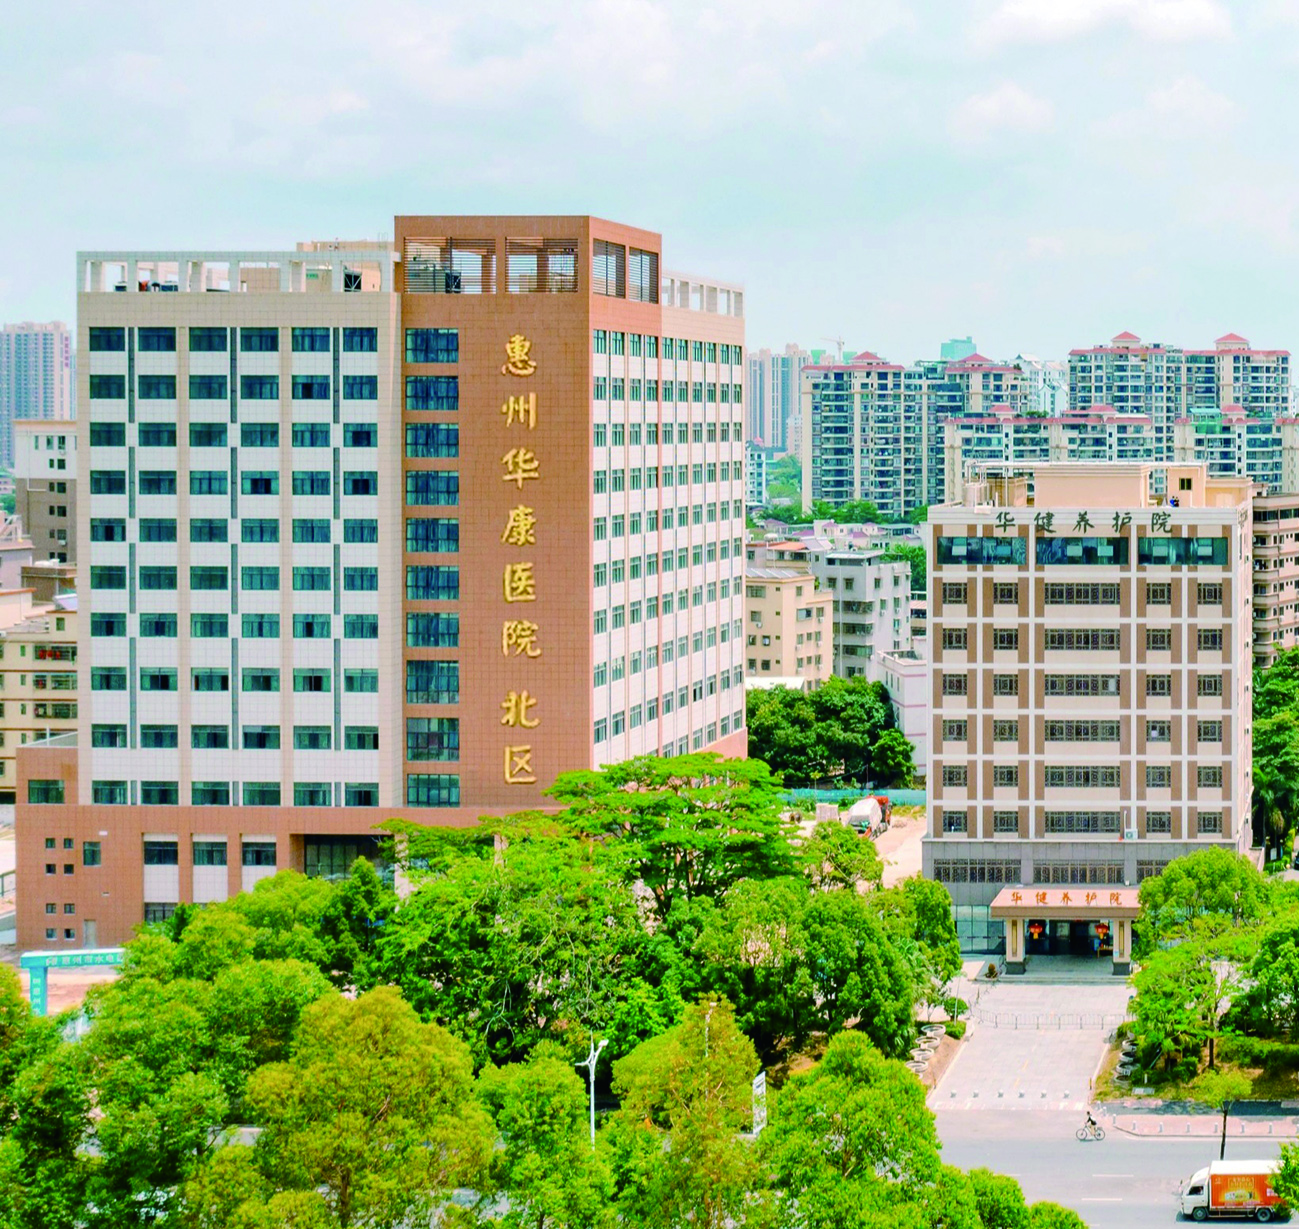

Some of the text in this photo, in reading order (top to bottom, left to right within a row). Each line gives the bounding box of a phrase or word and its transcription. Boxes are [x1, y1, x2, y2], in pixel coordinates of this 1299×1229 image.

[995, 511, 1173, 534] 华健养护院
[1010, 891, 1123, 906] 华健养护院
